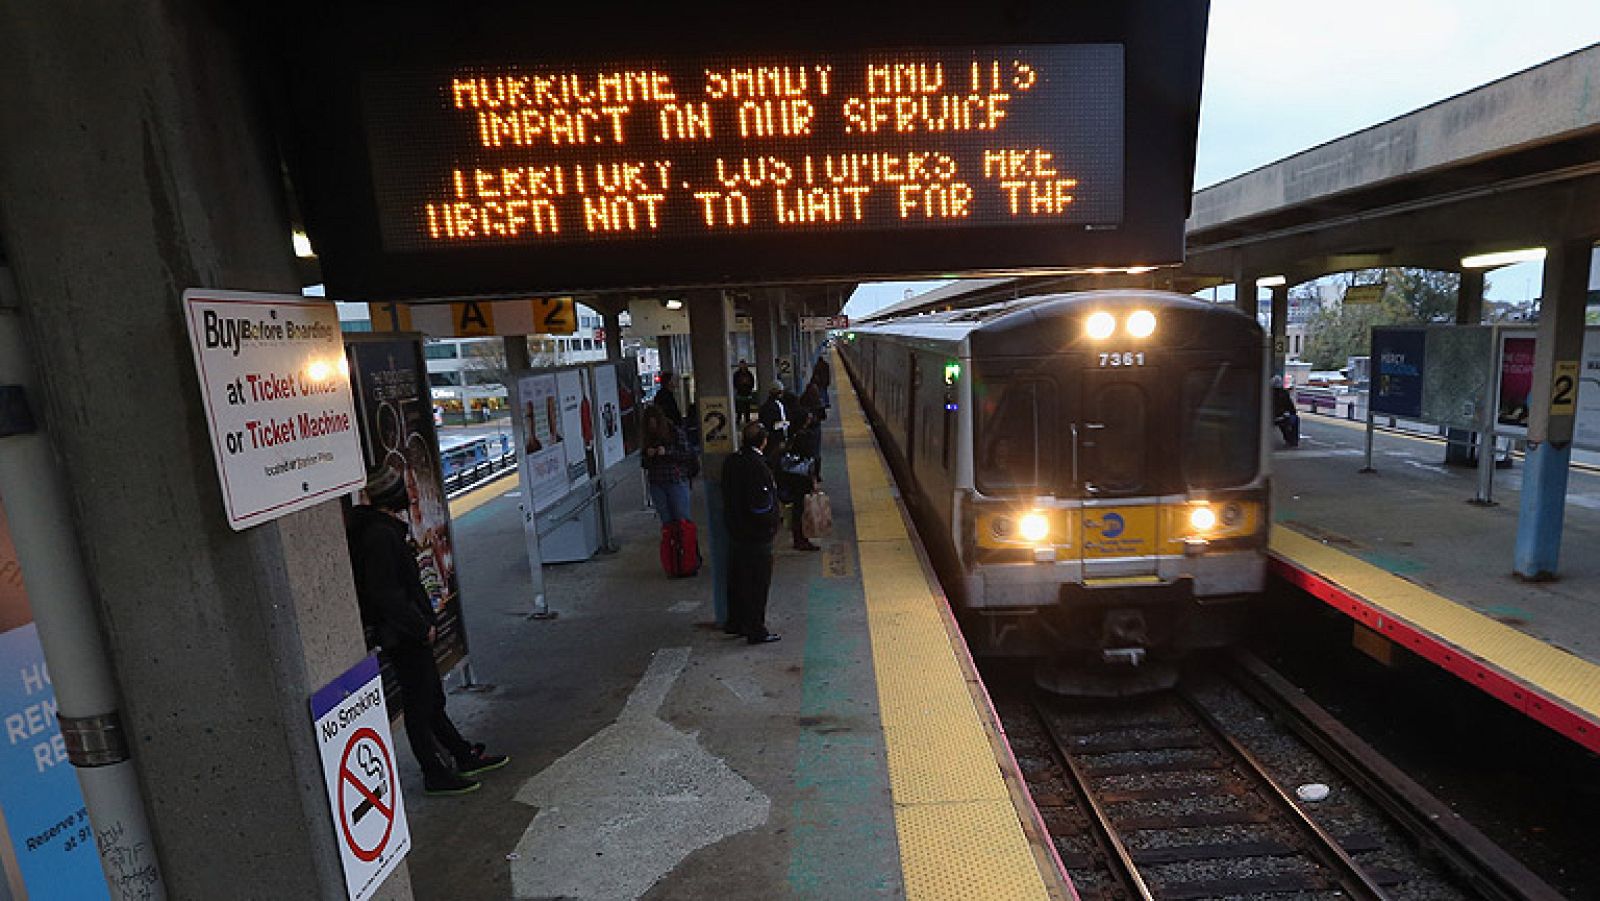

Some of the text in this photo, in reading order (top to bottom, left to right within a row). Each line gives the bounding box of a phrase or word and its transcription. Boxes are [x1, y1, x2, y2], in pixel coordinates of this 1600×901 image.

[478, 104, 629, 146] IMPACT
[776, 185, 869, 224] WAIT
[461, 301, 487, 330] A
[542, 297, 566, 327] 2
[203, 310, 333, 357] Buy Before Boarding
[226, 376, 246, 406] at
[246, 372, 297, 403] Ticket
[1553, 374, 1574, 405] 2
[226, 409, 350, 455] or Ticket Machine
[703, 411, 728, 443] 2
[321, 686, 381, 743] No Smoking
[25, 812, 74, 852] Reserve
[63, 836, 78, 852] at
